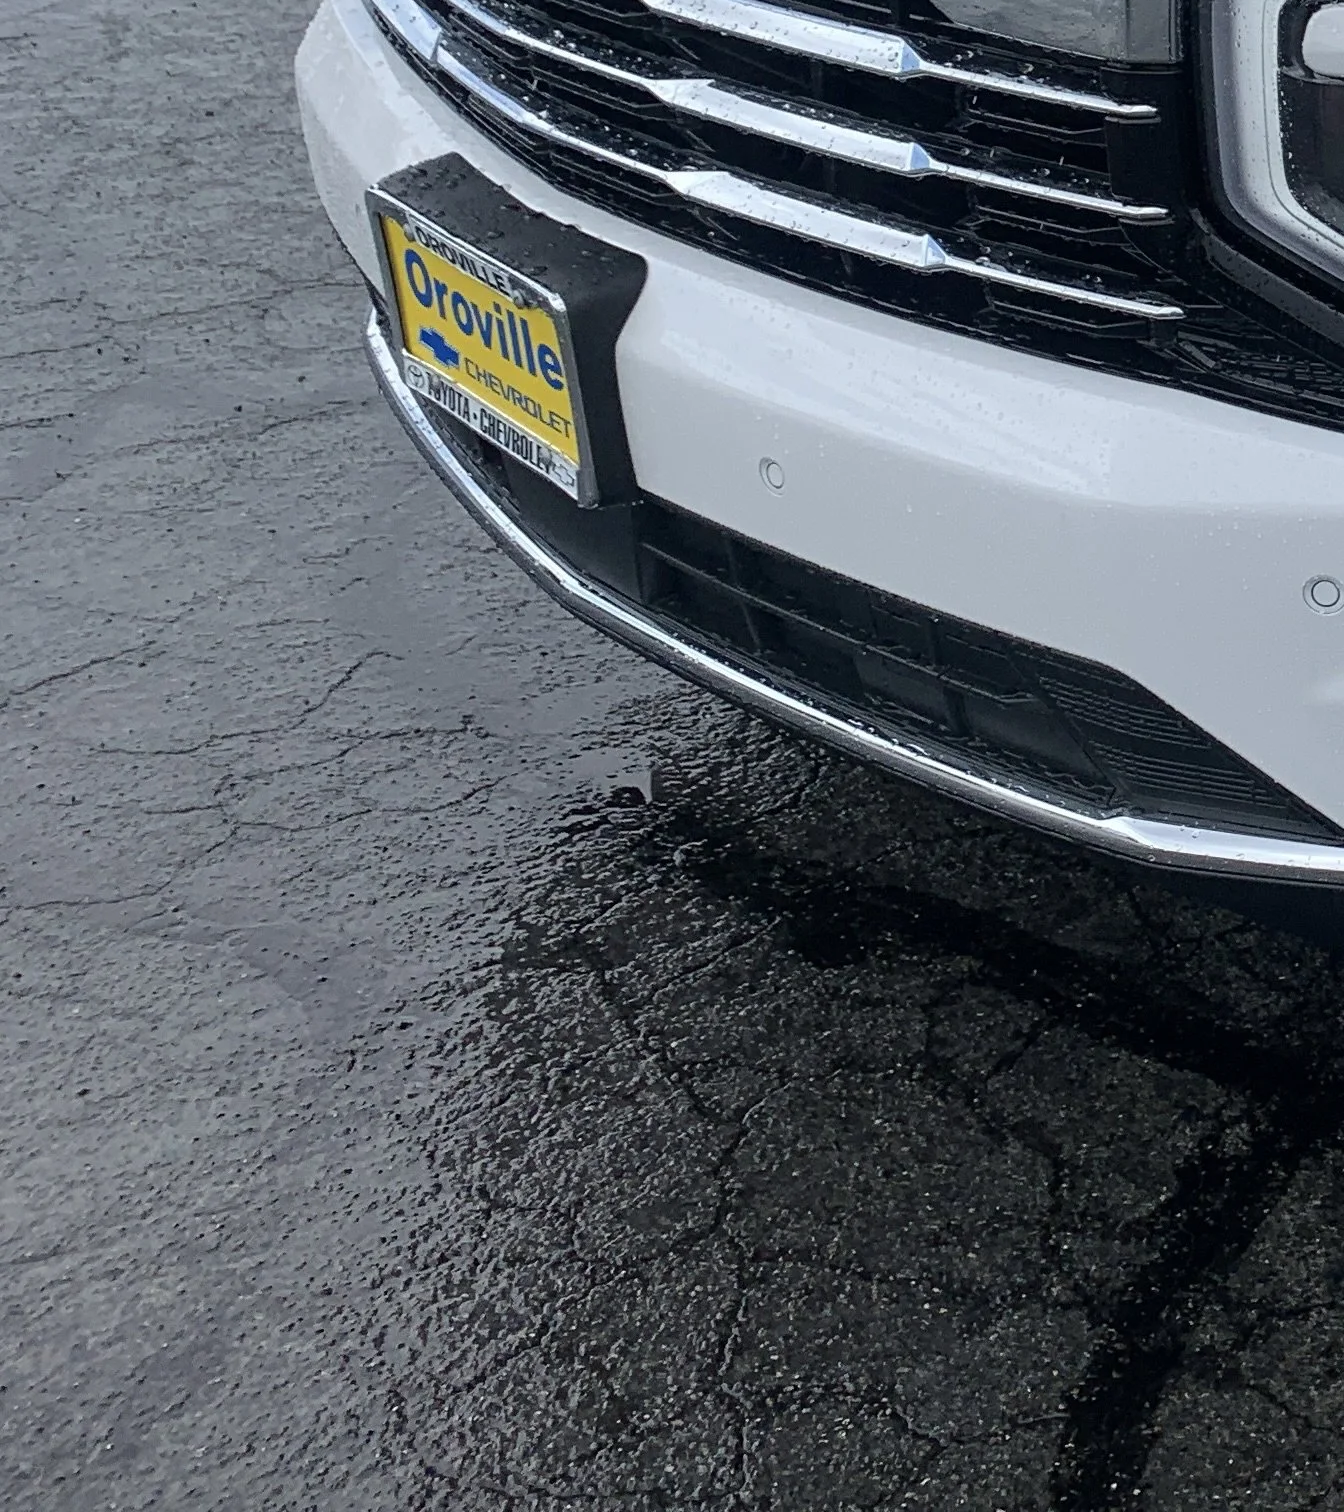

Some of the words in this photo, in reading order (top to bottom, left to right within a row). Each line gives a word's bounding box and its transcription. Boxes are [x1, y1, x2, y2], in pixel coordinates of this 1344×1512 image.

[415, 226, 510, 296] OROVILLE
[405, 248, 565, 392] Oroville
[464, 357, 572, 439] CHEVROLET
